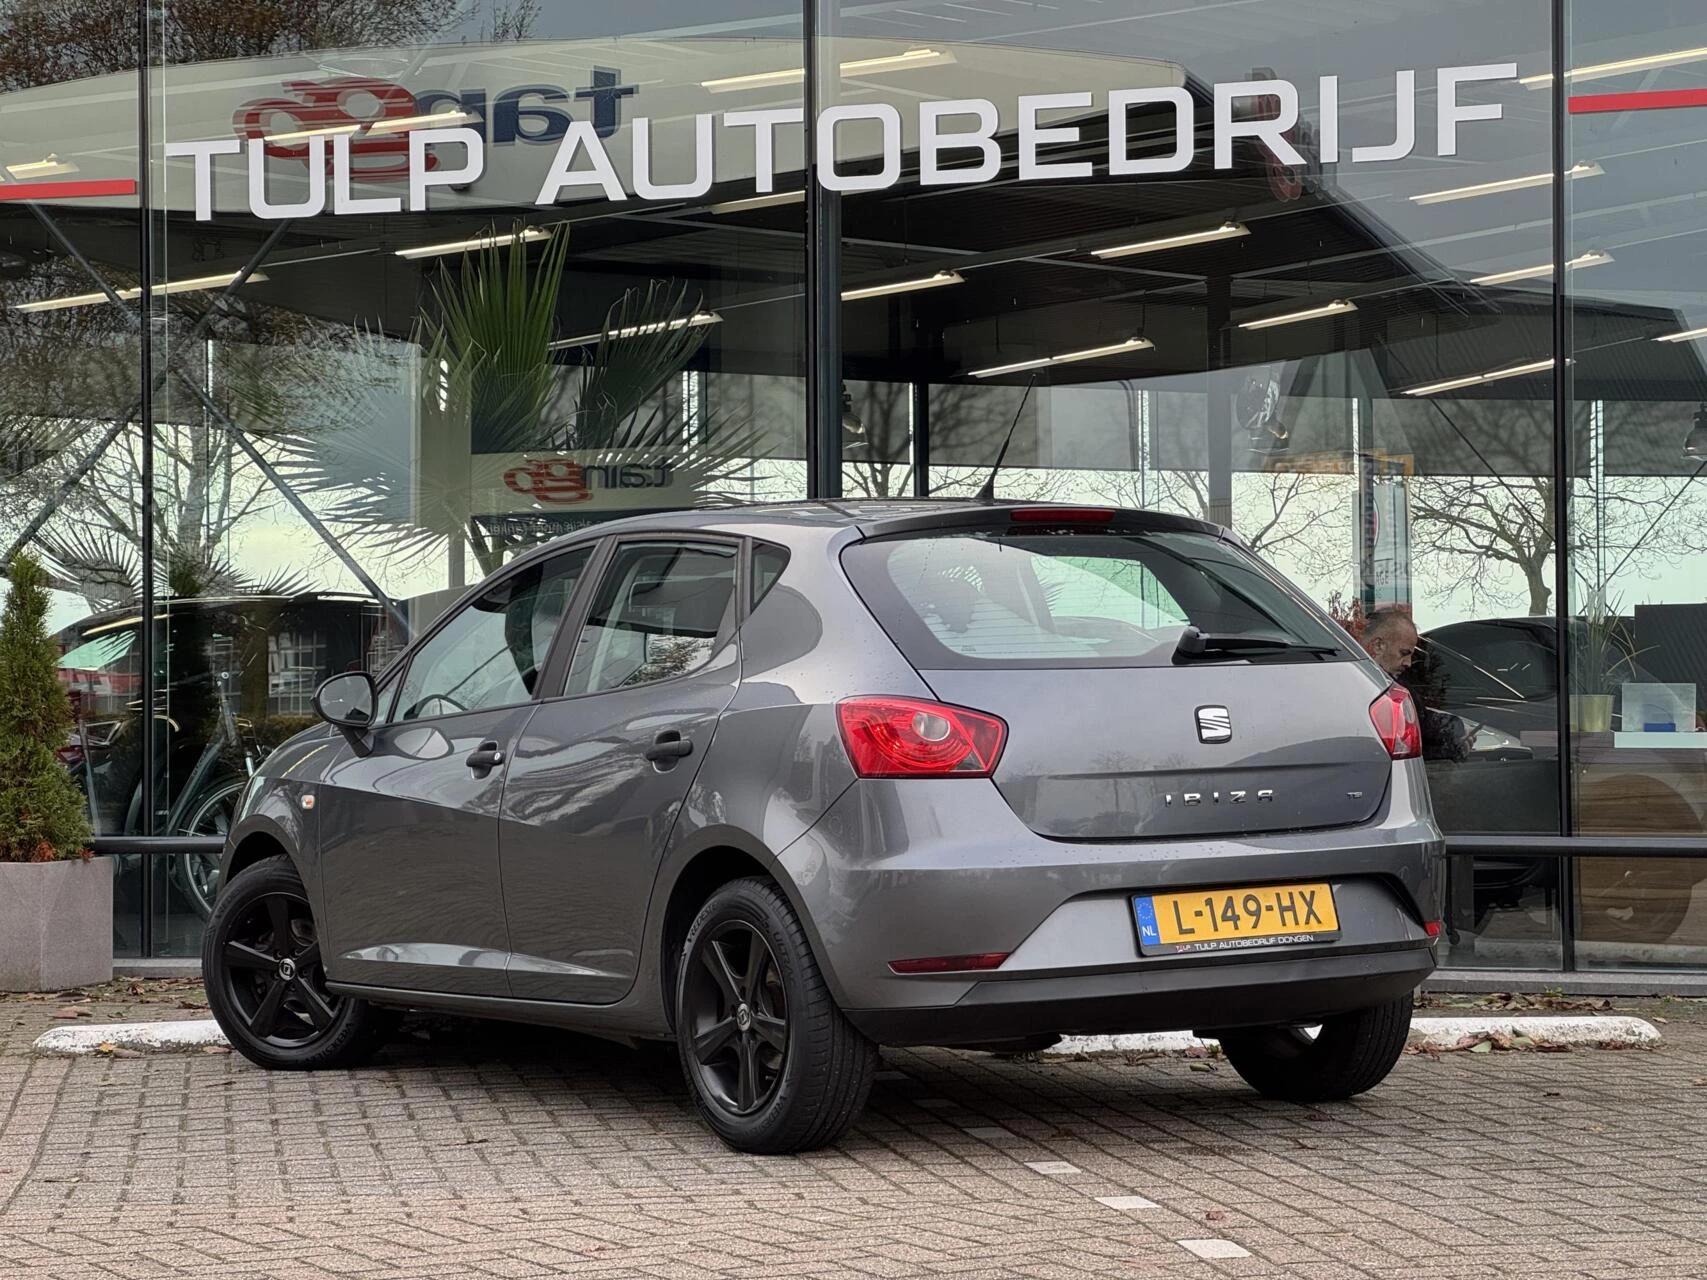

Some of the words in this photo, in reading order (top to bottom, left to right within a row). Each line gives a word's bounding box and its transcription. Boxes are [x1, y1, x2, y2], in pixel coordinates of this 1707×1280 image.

[165, 139, 484, 221] TULP
[535, 62, 1518, 206] AUTOBEDRIJF
[1165, 789, 1273, 807] IBIZA
[1172, 889, 1322, 935] L-149-HX
[1142, 925, 1157, 937] NL
[1194, 942, 1217, 951] TULP
[1219, 937, 1277, 949] AUTOBEDRIJF
[1278, 934, 1314, 944] DONGEN
